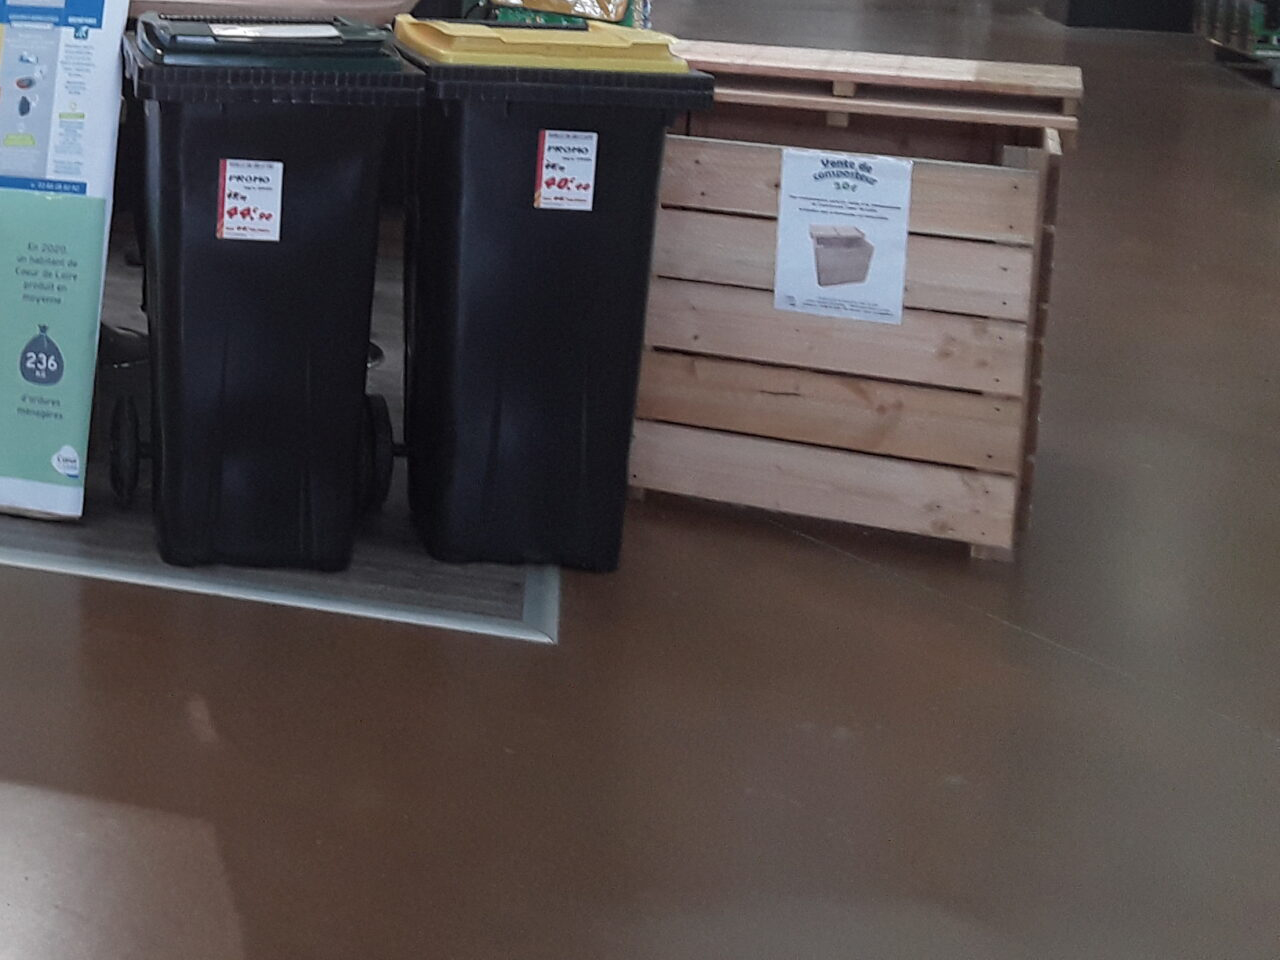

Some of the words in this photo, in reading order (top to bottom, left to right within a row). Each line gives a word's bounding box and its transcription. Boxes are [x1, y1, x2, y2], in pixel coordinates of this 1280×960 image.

[821, 158, 855, 171] Vente
[859, 161, 873, 173] de
[41, 269, 53, 279] de
[23, 280, 55, 292] produit
[22, 293, 62, 305] moyenne
[26, 351, 58, 371] 236
